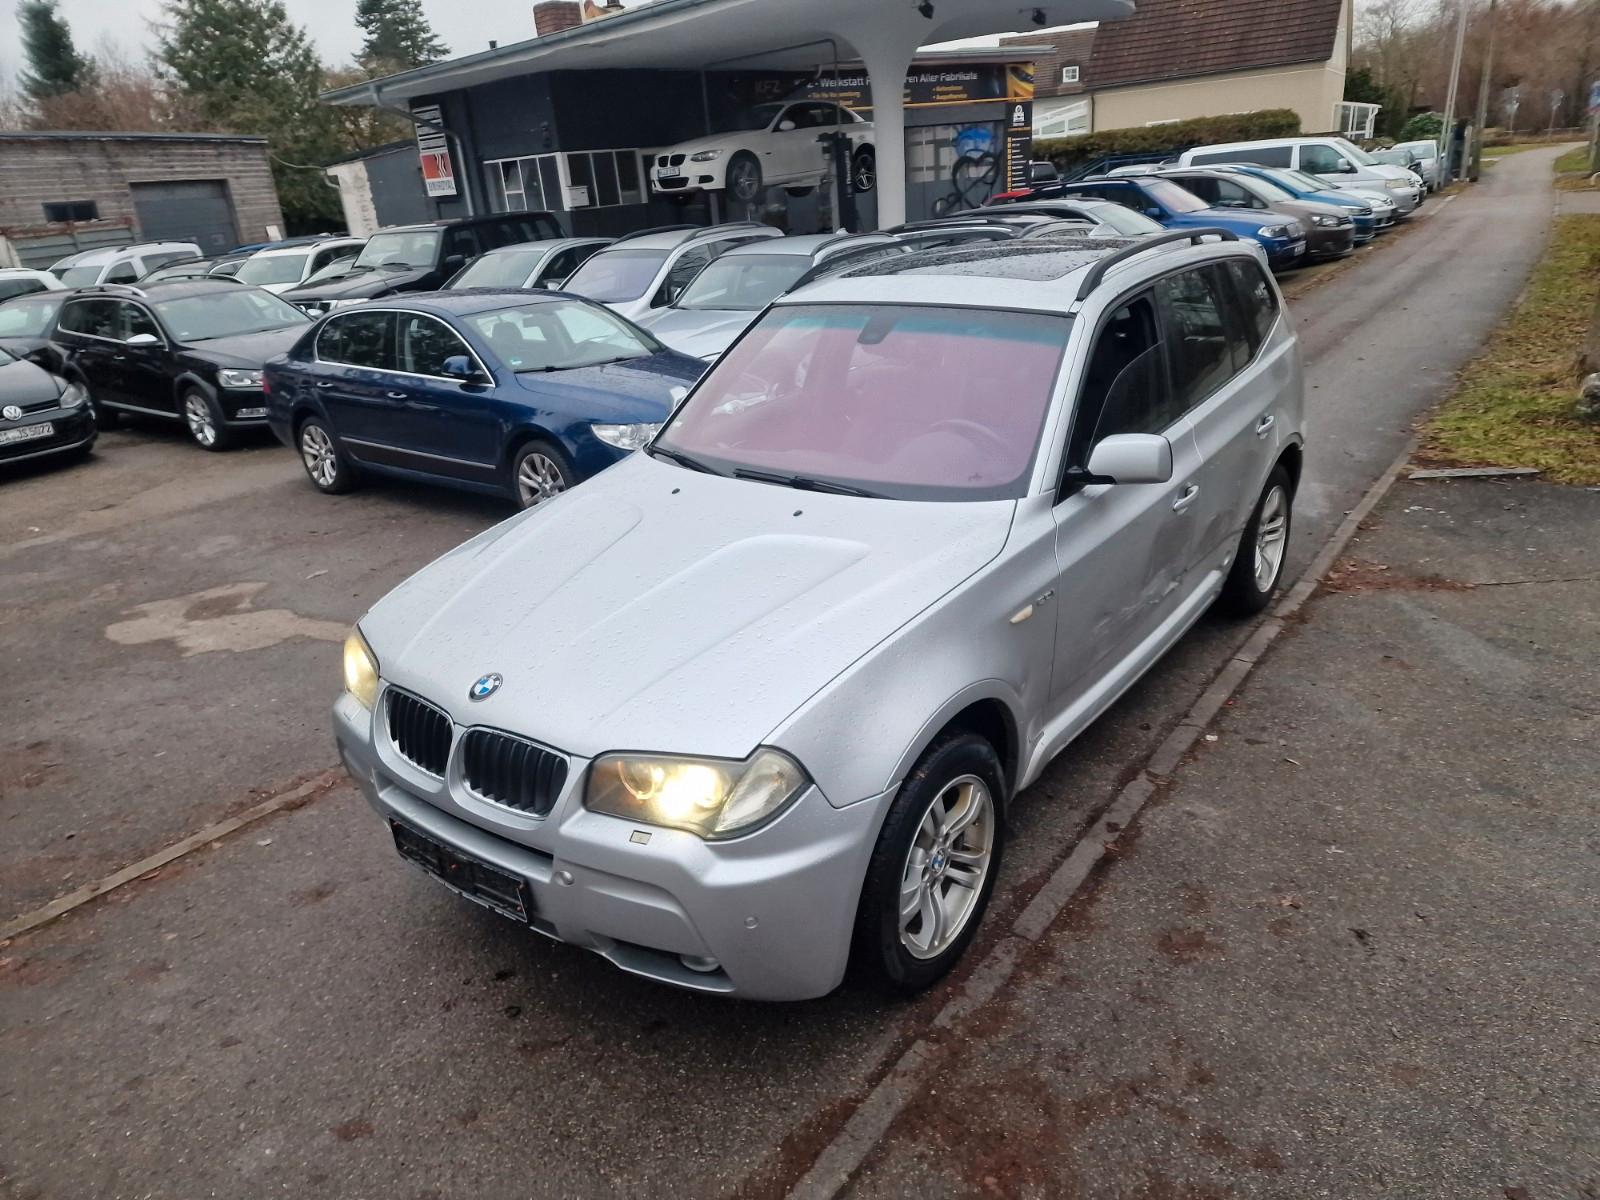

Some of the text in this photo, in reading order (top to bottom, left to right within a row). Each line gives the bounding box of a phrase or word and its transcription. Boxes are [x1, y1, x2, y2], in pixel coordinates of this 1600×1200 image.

[820, 78, 865, 88] Werkstatt
[920, 74, 939, 82] Aller
[940, 72, 978, 82] Fabrikate
